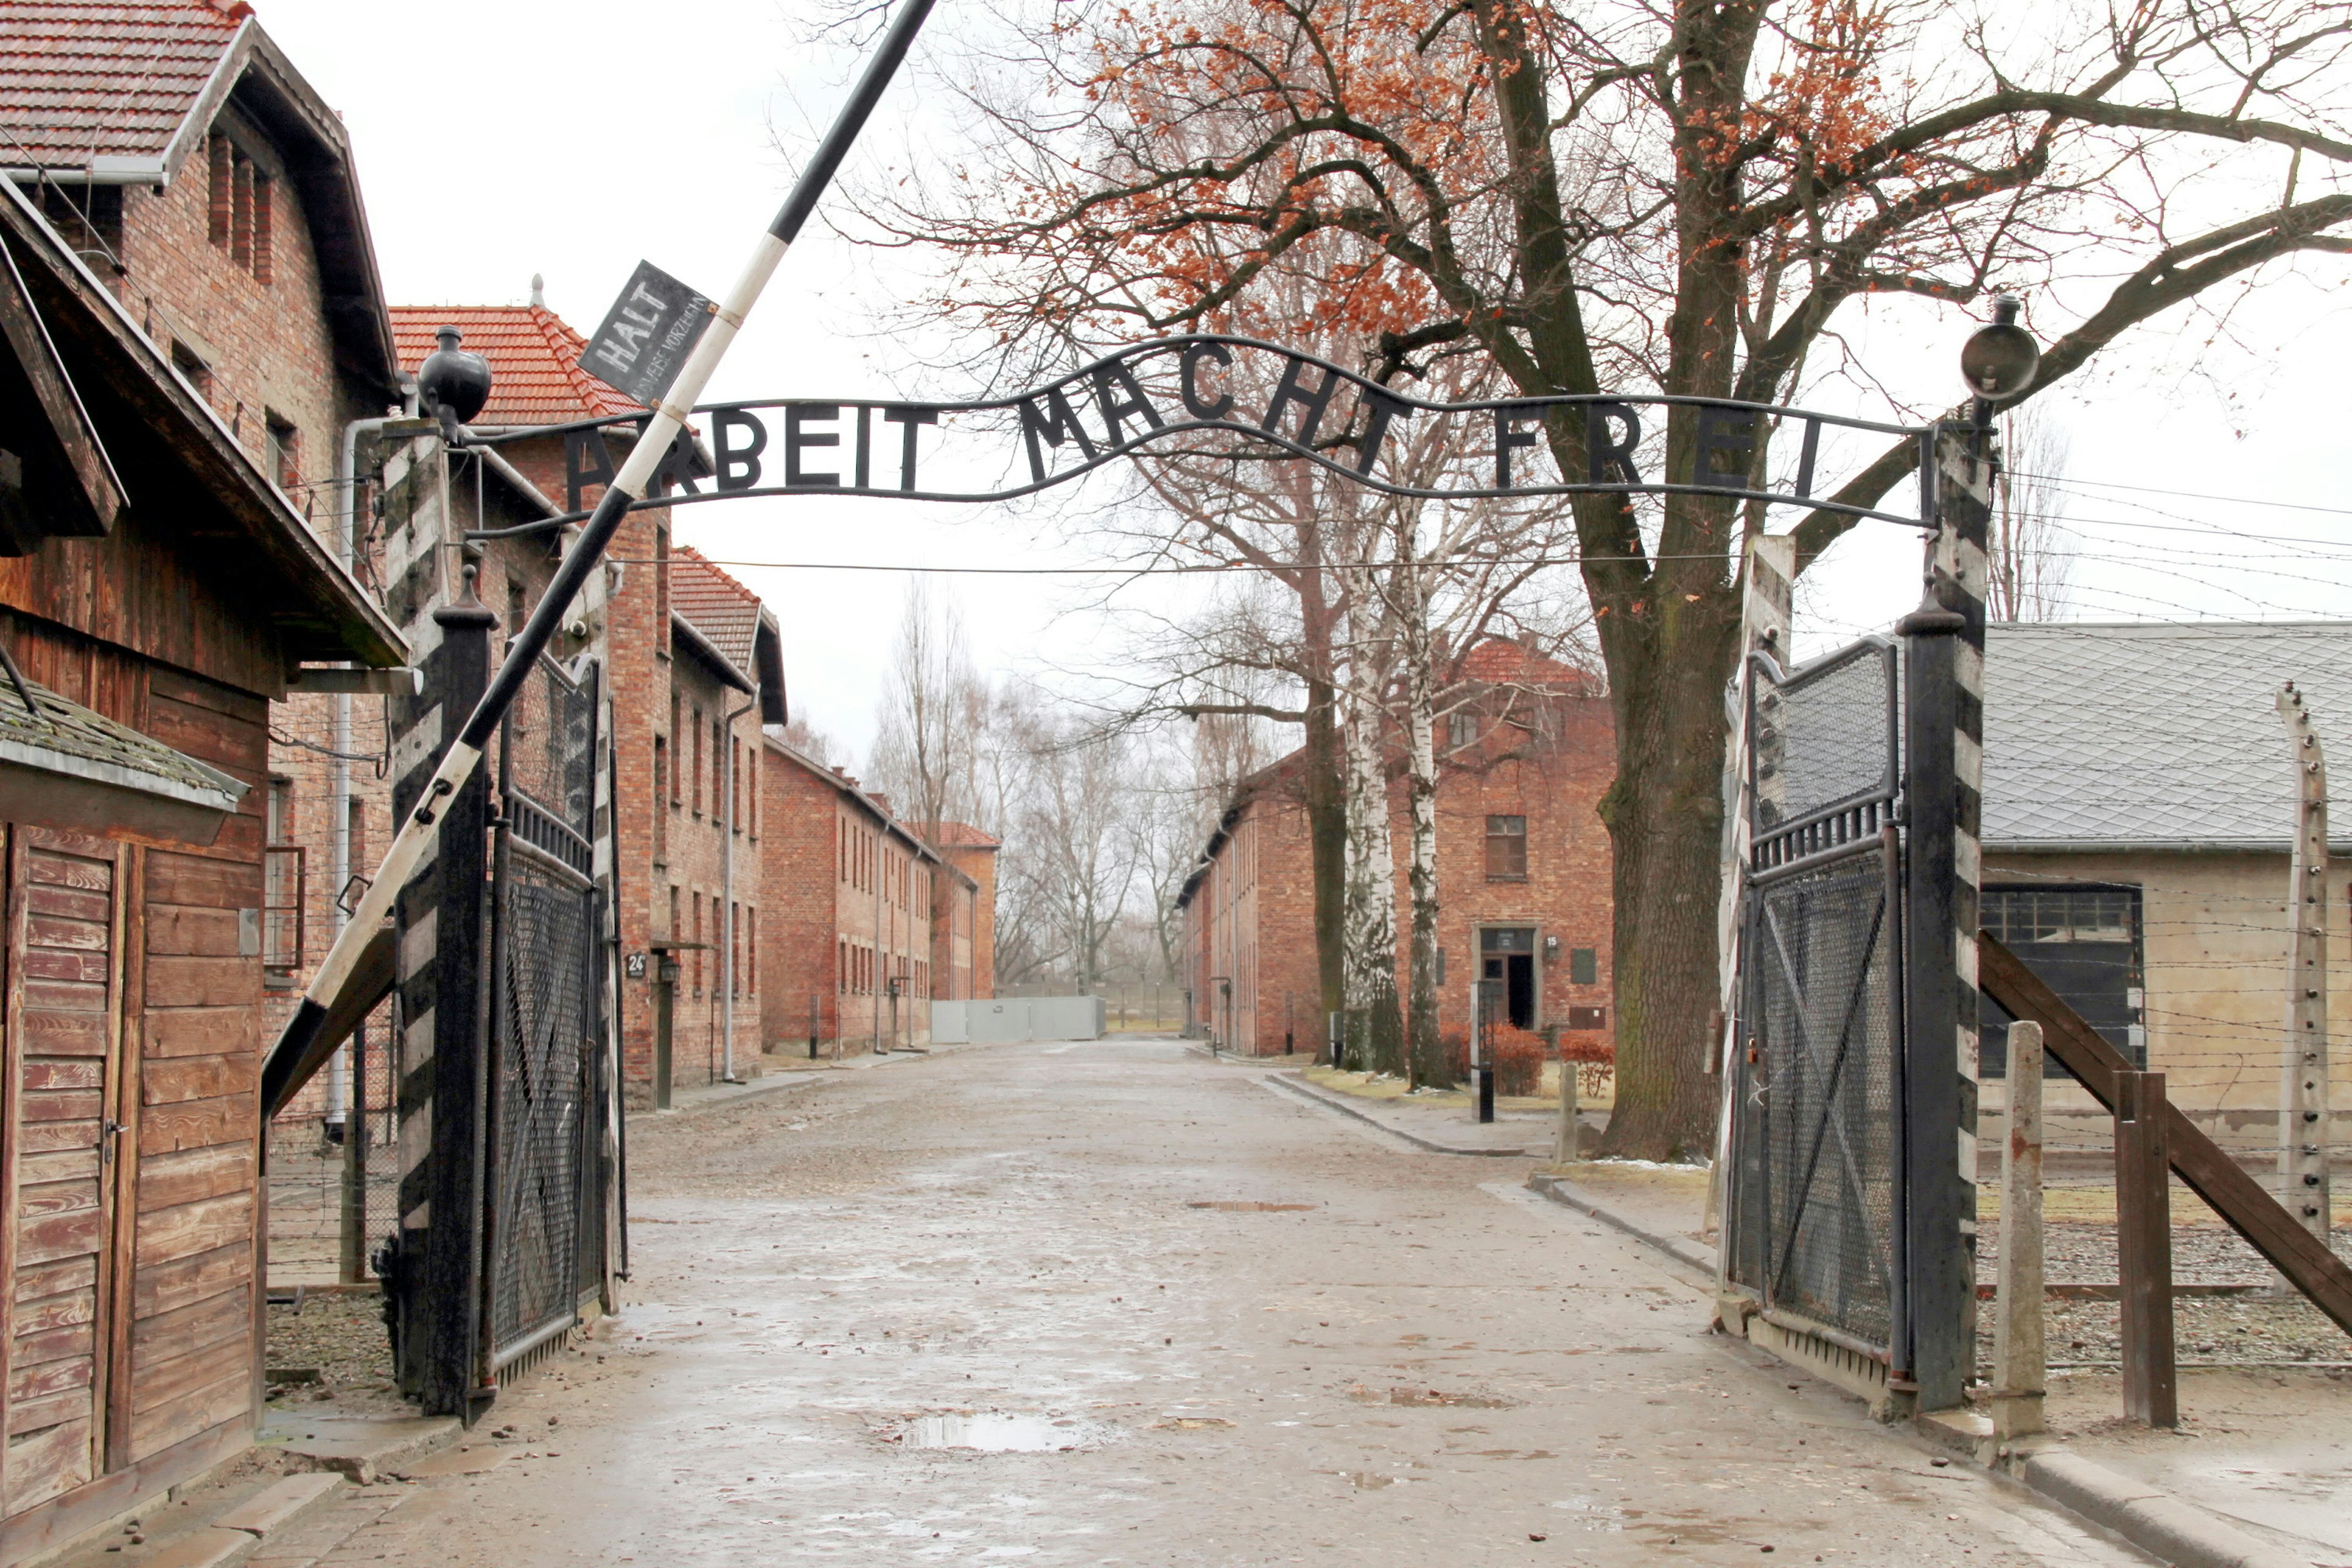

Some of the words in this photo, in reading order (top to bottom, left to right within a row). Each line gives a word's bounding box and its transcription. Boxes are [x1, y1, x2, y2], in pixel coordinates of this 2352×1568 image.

[595, 281, 668, 373] HALT
[564, 404, 938, 513] ARBEIT
[1018, 341, 1414, 483] MACHT
[1494, 402, 1822, 499] FREI
[1547, 937, 1556, 946] 15
